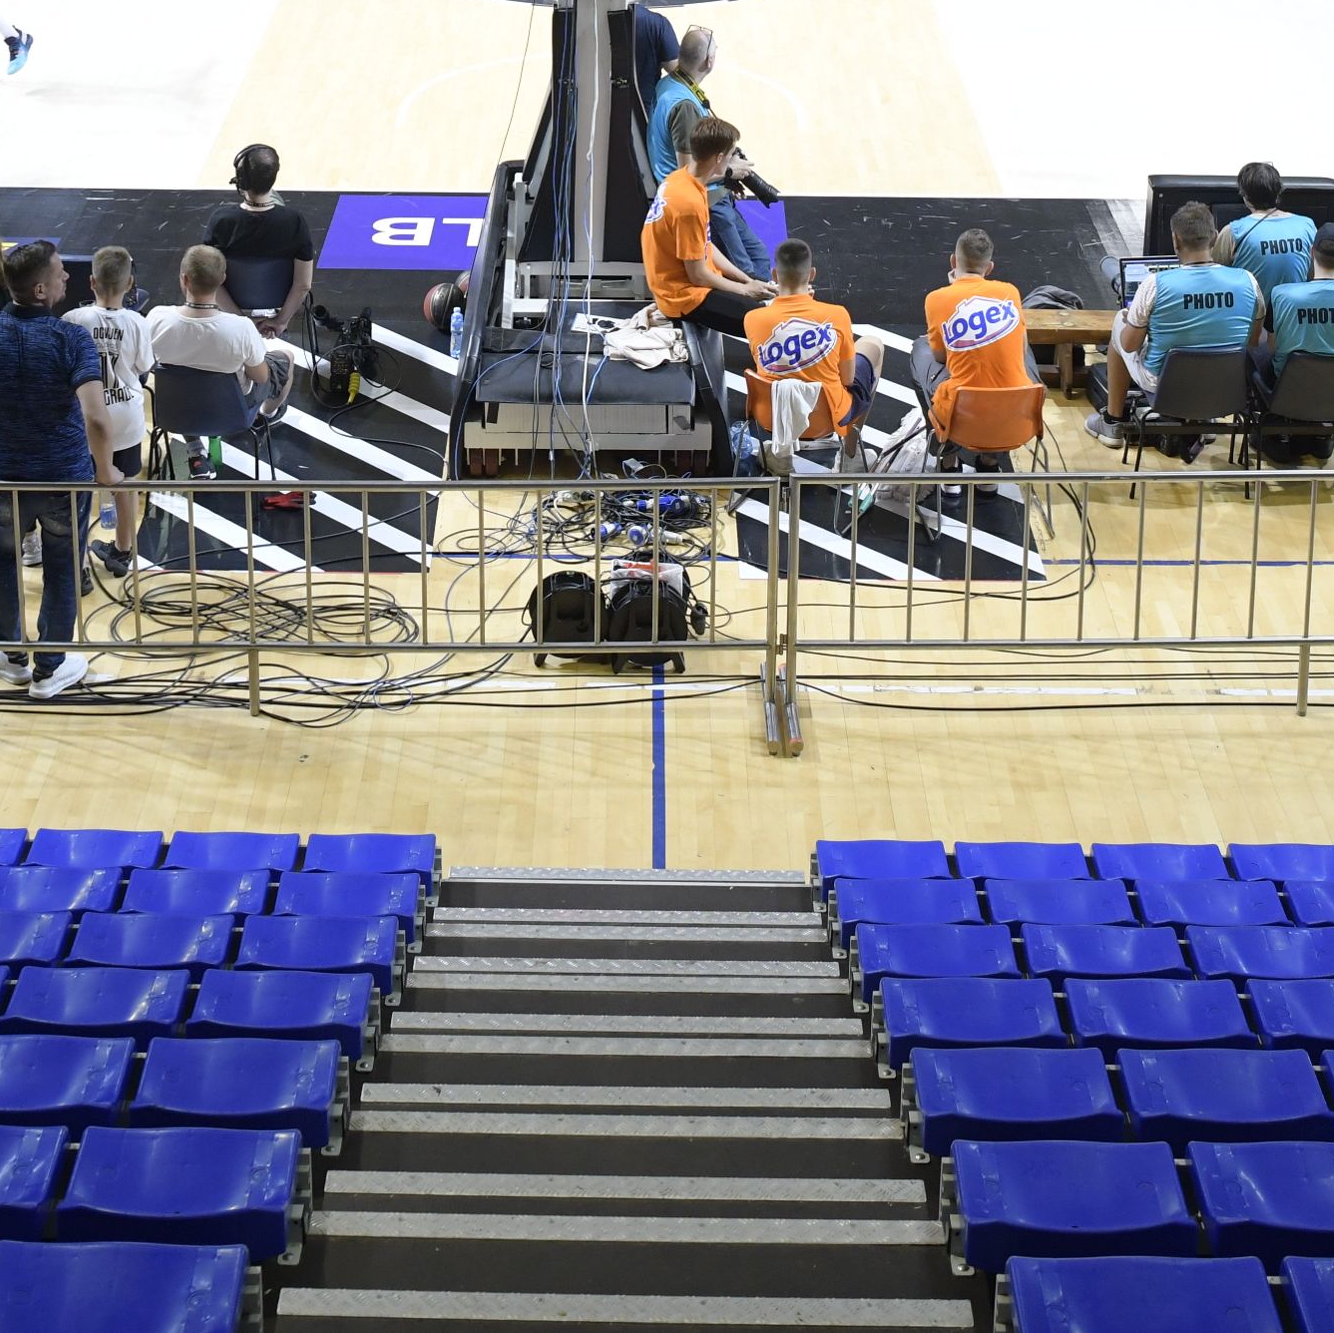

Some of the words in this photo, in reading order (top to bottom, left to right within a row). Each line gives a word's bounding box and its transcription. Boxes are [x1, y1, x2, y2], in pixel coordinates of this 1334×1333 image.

[1260, 238, 1303, 256] PHOTO
[1183, 292, 1234, 310] PHOTO
[942, 300, 1017, 343] Logex
[758, 323, 833, 366] Logex
